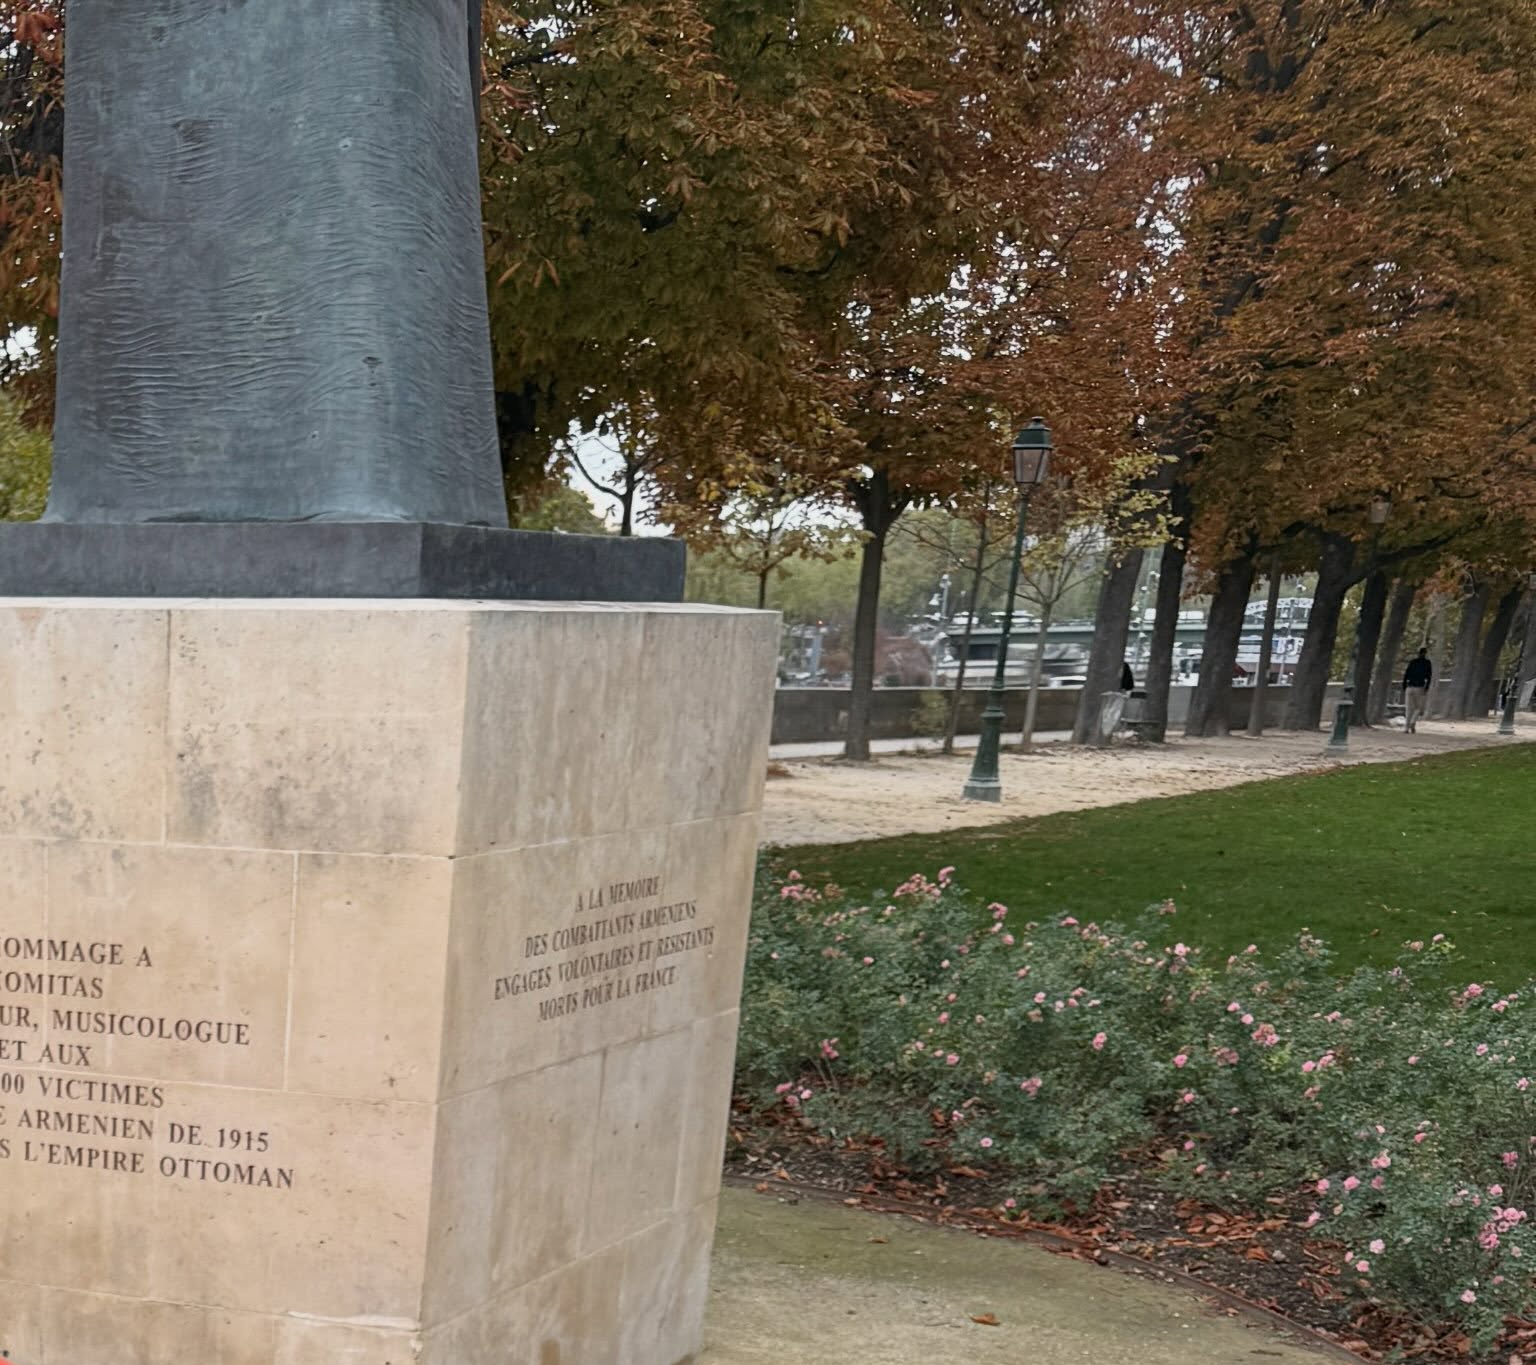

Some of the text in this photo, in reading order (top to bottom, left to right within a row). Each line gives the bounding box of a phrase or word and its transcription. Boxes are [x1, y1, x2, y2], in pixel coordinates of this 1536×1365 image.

[589, 888, 603, 909] LA
[609, 876, 659, 904] MEMOIRE
[525, 900, 696, 958] DES COMBATTANTS ARMENIENS
[136, 946, 152, 967] A
[494, 926, 715, 1000] ENGAGES VOLONTAIRES ET RESISTANTS
[539, 966, 676, 1020] MORTS POUR LA FRANCE
[52, 1010, 251, 1046] MUSICOLOGUE
[38, 1044, 93, 1067] AUX
[38, 1076, 164, 1108] VICTIMES
[17, 1109, 155, 1141] ARMENIEN
[168, 1123, 203, 1146] DE
[216, 1127, 270, 1153] 1915
[24, 1141, 146, 1174] L'EMPIRE
[159, 1156, 296, 1189] OTTOMAN
